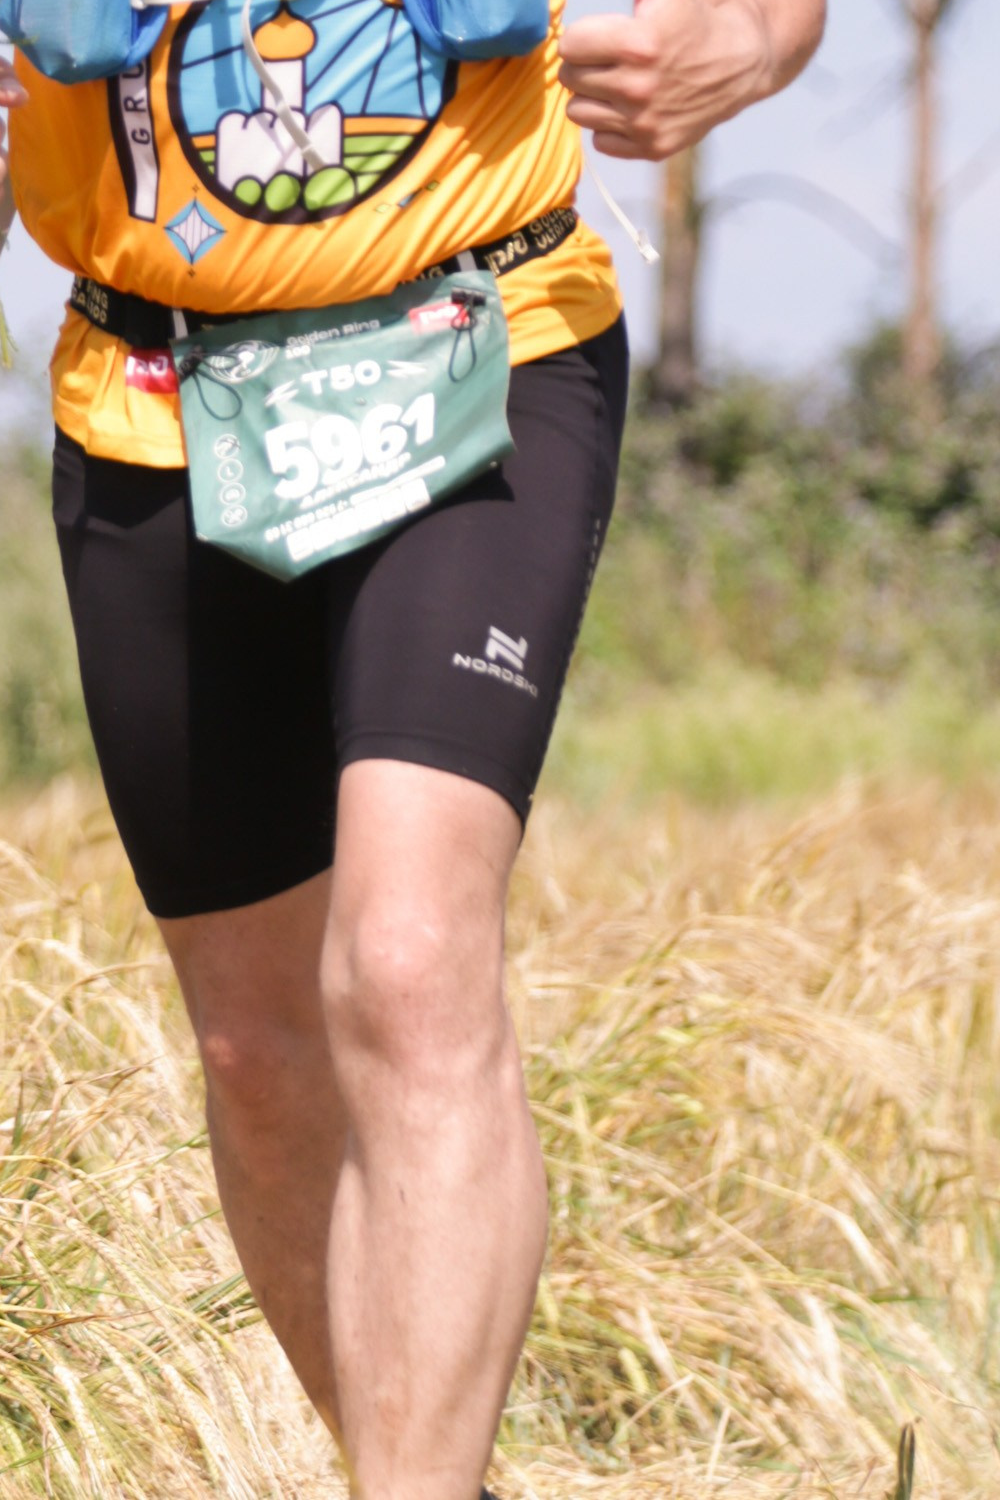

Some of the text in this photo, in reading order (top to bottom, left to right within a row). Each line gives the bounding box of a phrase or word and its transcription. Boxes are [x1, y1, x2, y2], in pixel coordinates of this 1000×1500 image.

[287, 319, 380, 347] Golden Ring
[302, 359, 382, 396] T50
[265, 392, 436, 500] 5961
